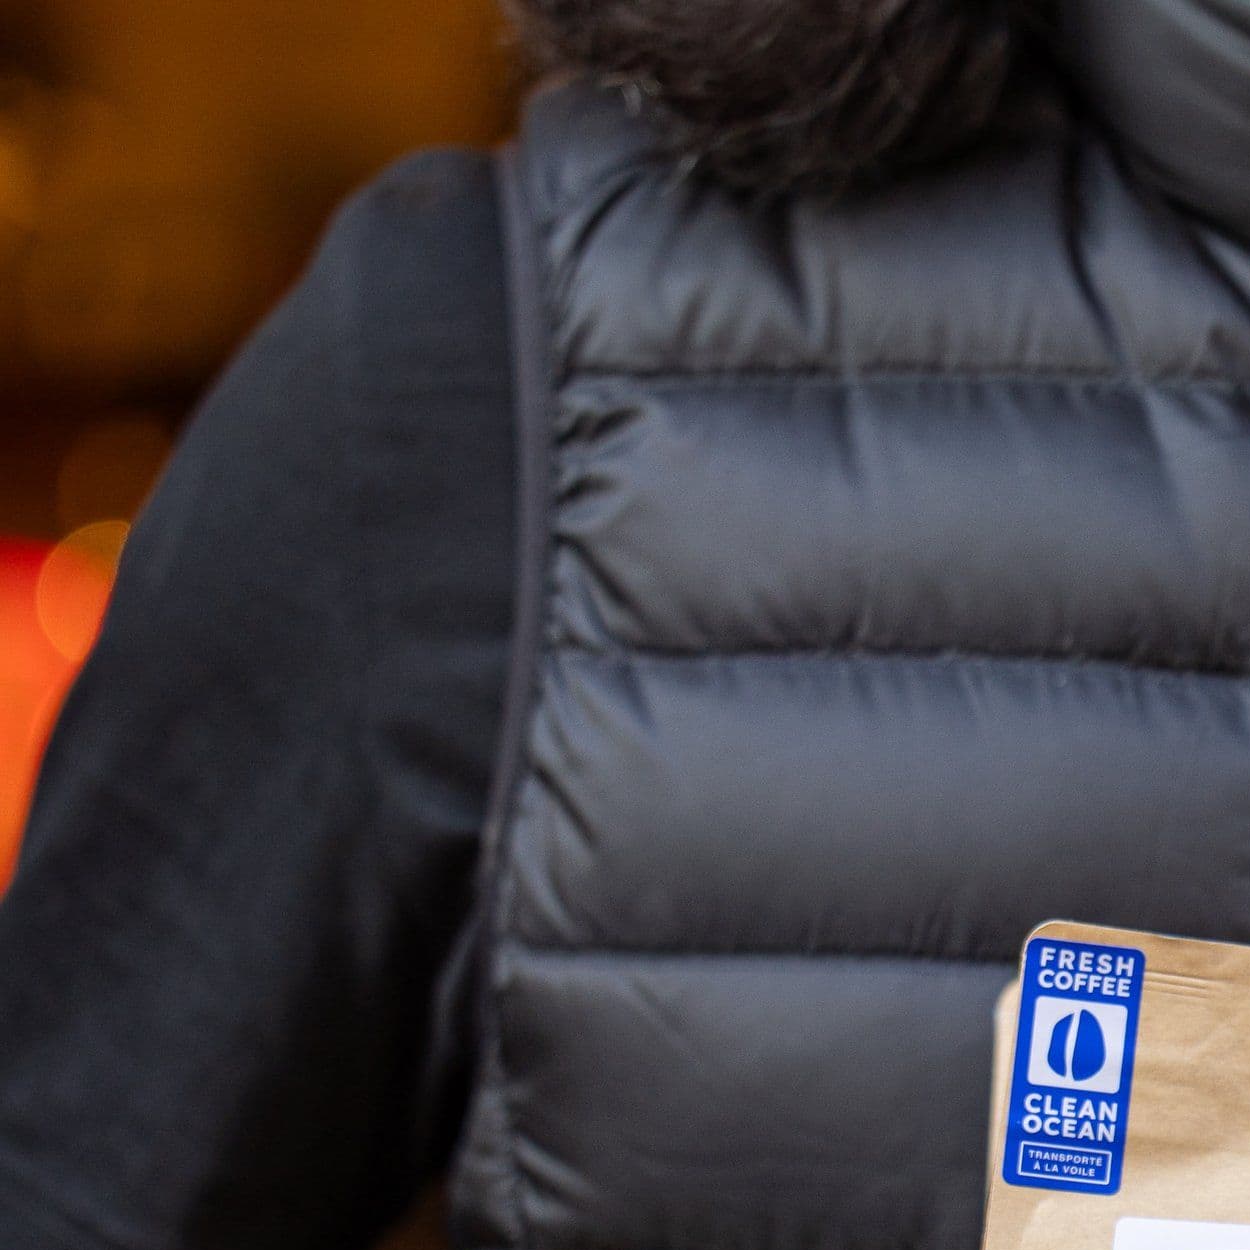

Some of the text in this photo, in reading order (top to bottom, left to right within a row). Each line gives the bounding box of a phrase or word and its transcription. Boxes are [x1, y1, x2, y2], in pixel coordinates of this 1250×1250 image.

[1040, 947, 1135, 977] FRESH
[1038, 969, 1132, 998] COFFEE
[1024, 1093, 1118, 1122] CLEAN
[1022, 1114, 1116, 1143] OCEAN
[1045, 1163, 1059, 1173] LA
[1063, 1165, 1096, 1177] VOILE
